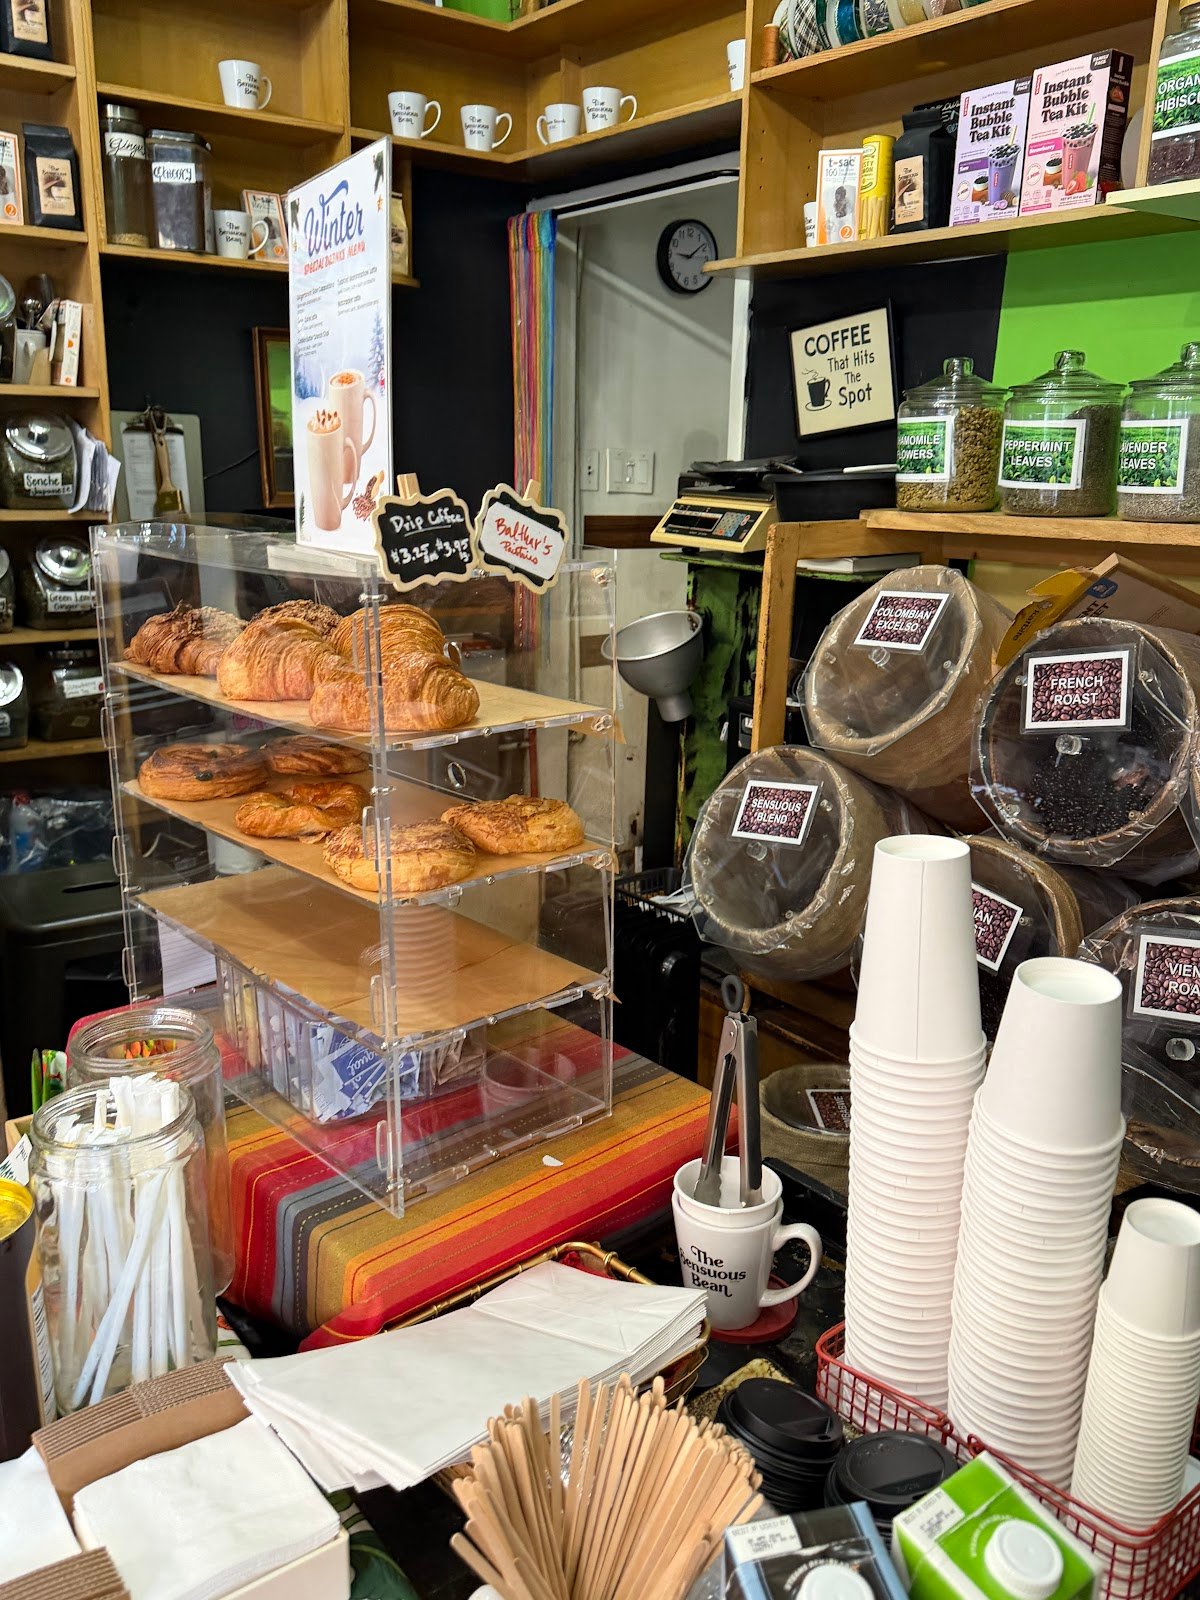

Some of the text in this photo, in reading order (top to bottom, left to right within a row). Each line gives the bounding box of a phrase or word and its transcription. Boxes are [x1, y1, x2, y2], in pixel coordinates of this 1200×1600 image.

[1043, 73, 1093, 95] Instant
[971, 97, 1016, 117] Instant
[1042, 87, 1090, 109] Bubble
[970, 110, 1013, 130] Bubble
[1041, 101, 1088, 123] Tea Kit
[969, 124, 1011, 143] Tea Kit
[303, 179, 364, 257] Winter
[805, 323, 871, 357] COFFEE
[827, 349, 875, 373] That Hits
[845, 371, 862, 384] The
[839, 383, 872, 409] Spot
[1005, 440, 1072, 452] PEPPERMINT
[1011, 455, 1053, 467] LEAVES
[1121, 458, 1156, 470] LEAVES
[389, 506, 465, 534] Drip Coffee
[390, 542, 430, 565] $3.25
[435, 537, 469, 558] $3.95
[876, 607, 932, 620] COLOMBIAN
[876, 620, 919, 632] EXCELSO
[1050, 675, 1104, 690] FRENCH
[1054, 692, 1099, 706] ROAST
[751, 798, 802, 812] SENSUOUS
[756, 812, 788, 824] BLEND
[1168, 980, 1200, 997] ROA
[347, 1049, 376, 1077] qual
[680, 1247, 747, 1281] Sensuous
[690, 1245, 724, 1268] The
[691, 1271, 733, 1298] Bean
